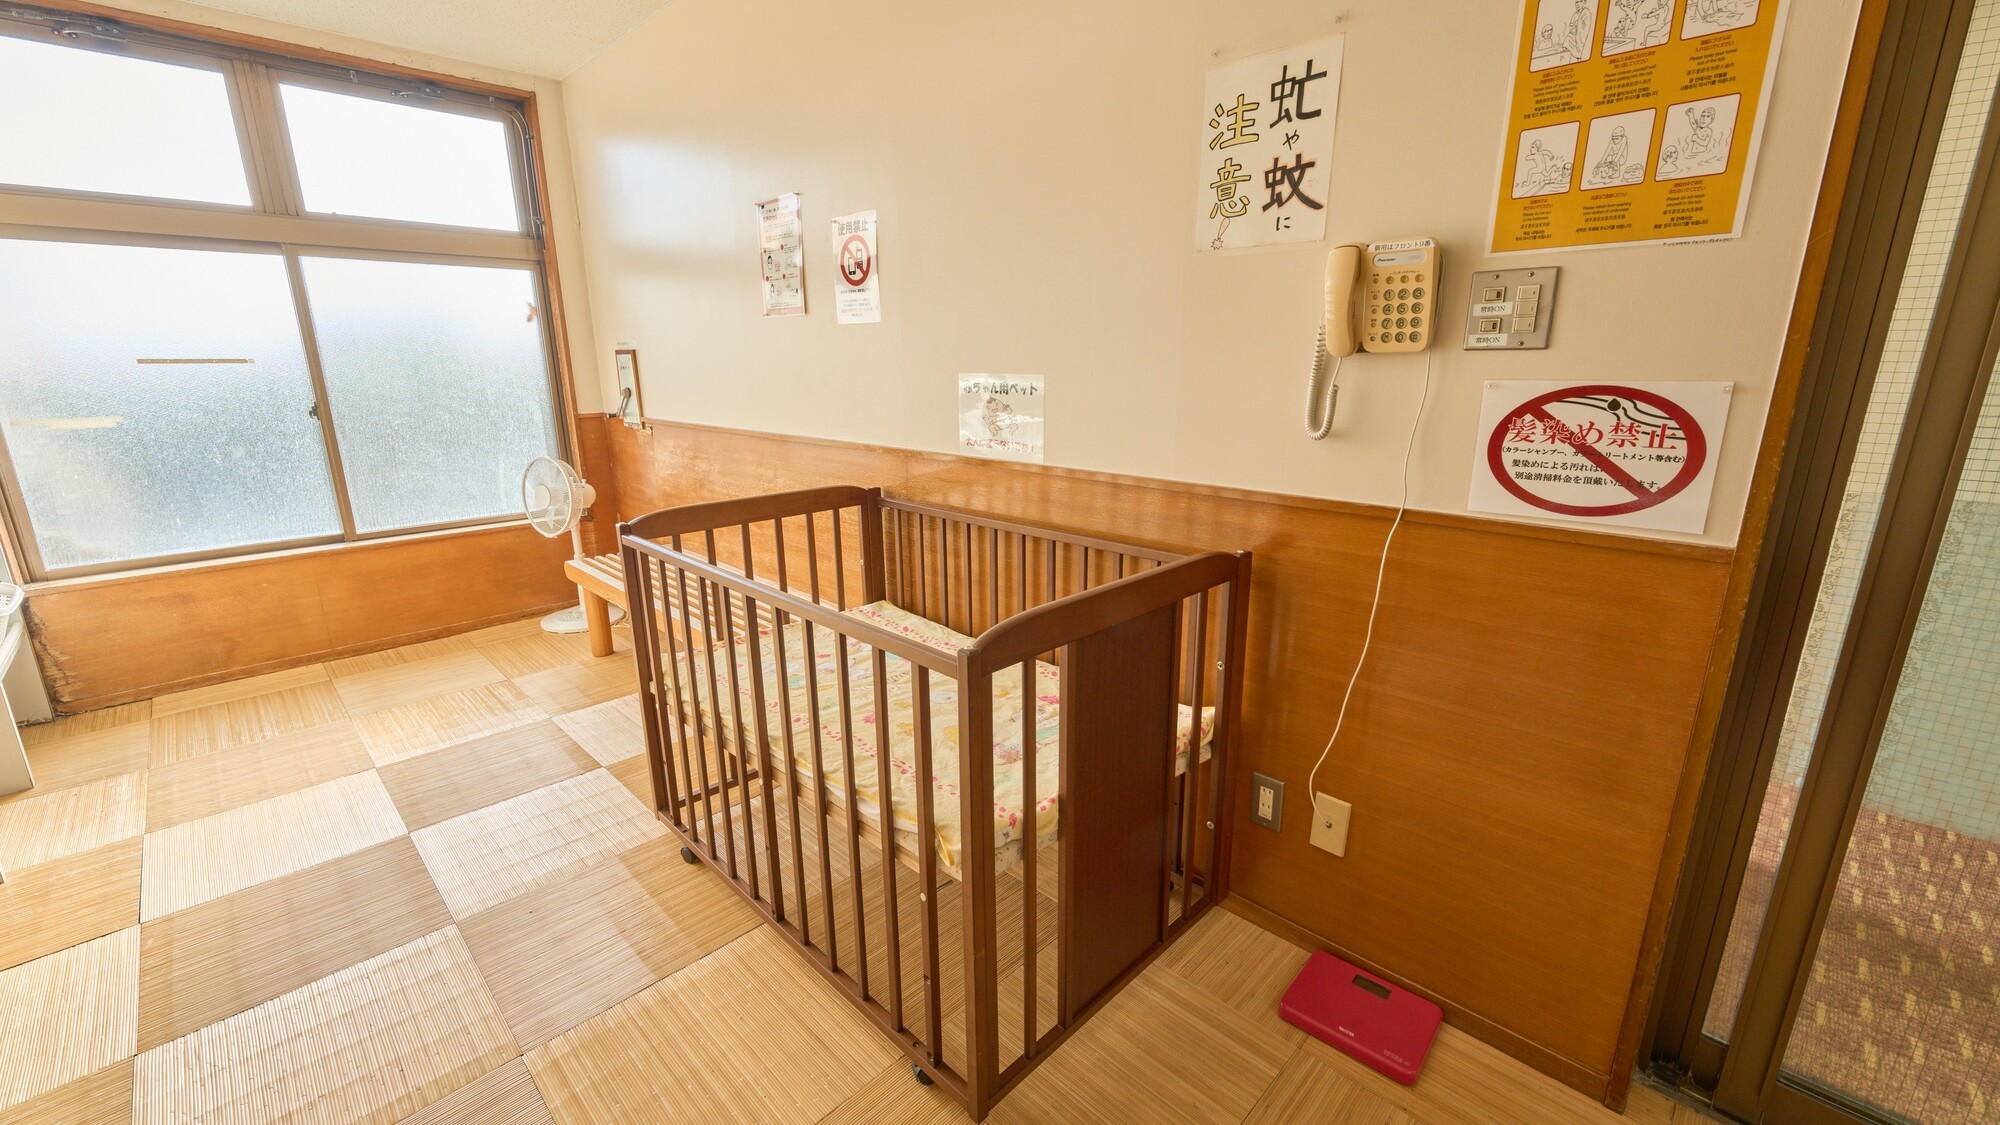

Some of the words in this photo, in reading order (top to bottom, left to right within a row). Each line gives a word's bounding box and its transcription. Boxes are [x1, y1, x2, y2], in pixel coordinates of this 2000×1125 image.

[1261, 59, 1327, 231] 虻や蚊に
[838, 218, 869, 236] 使用禁止
[1507, 416, 1677, 450] 髪染め禁止
